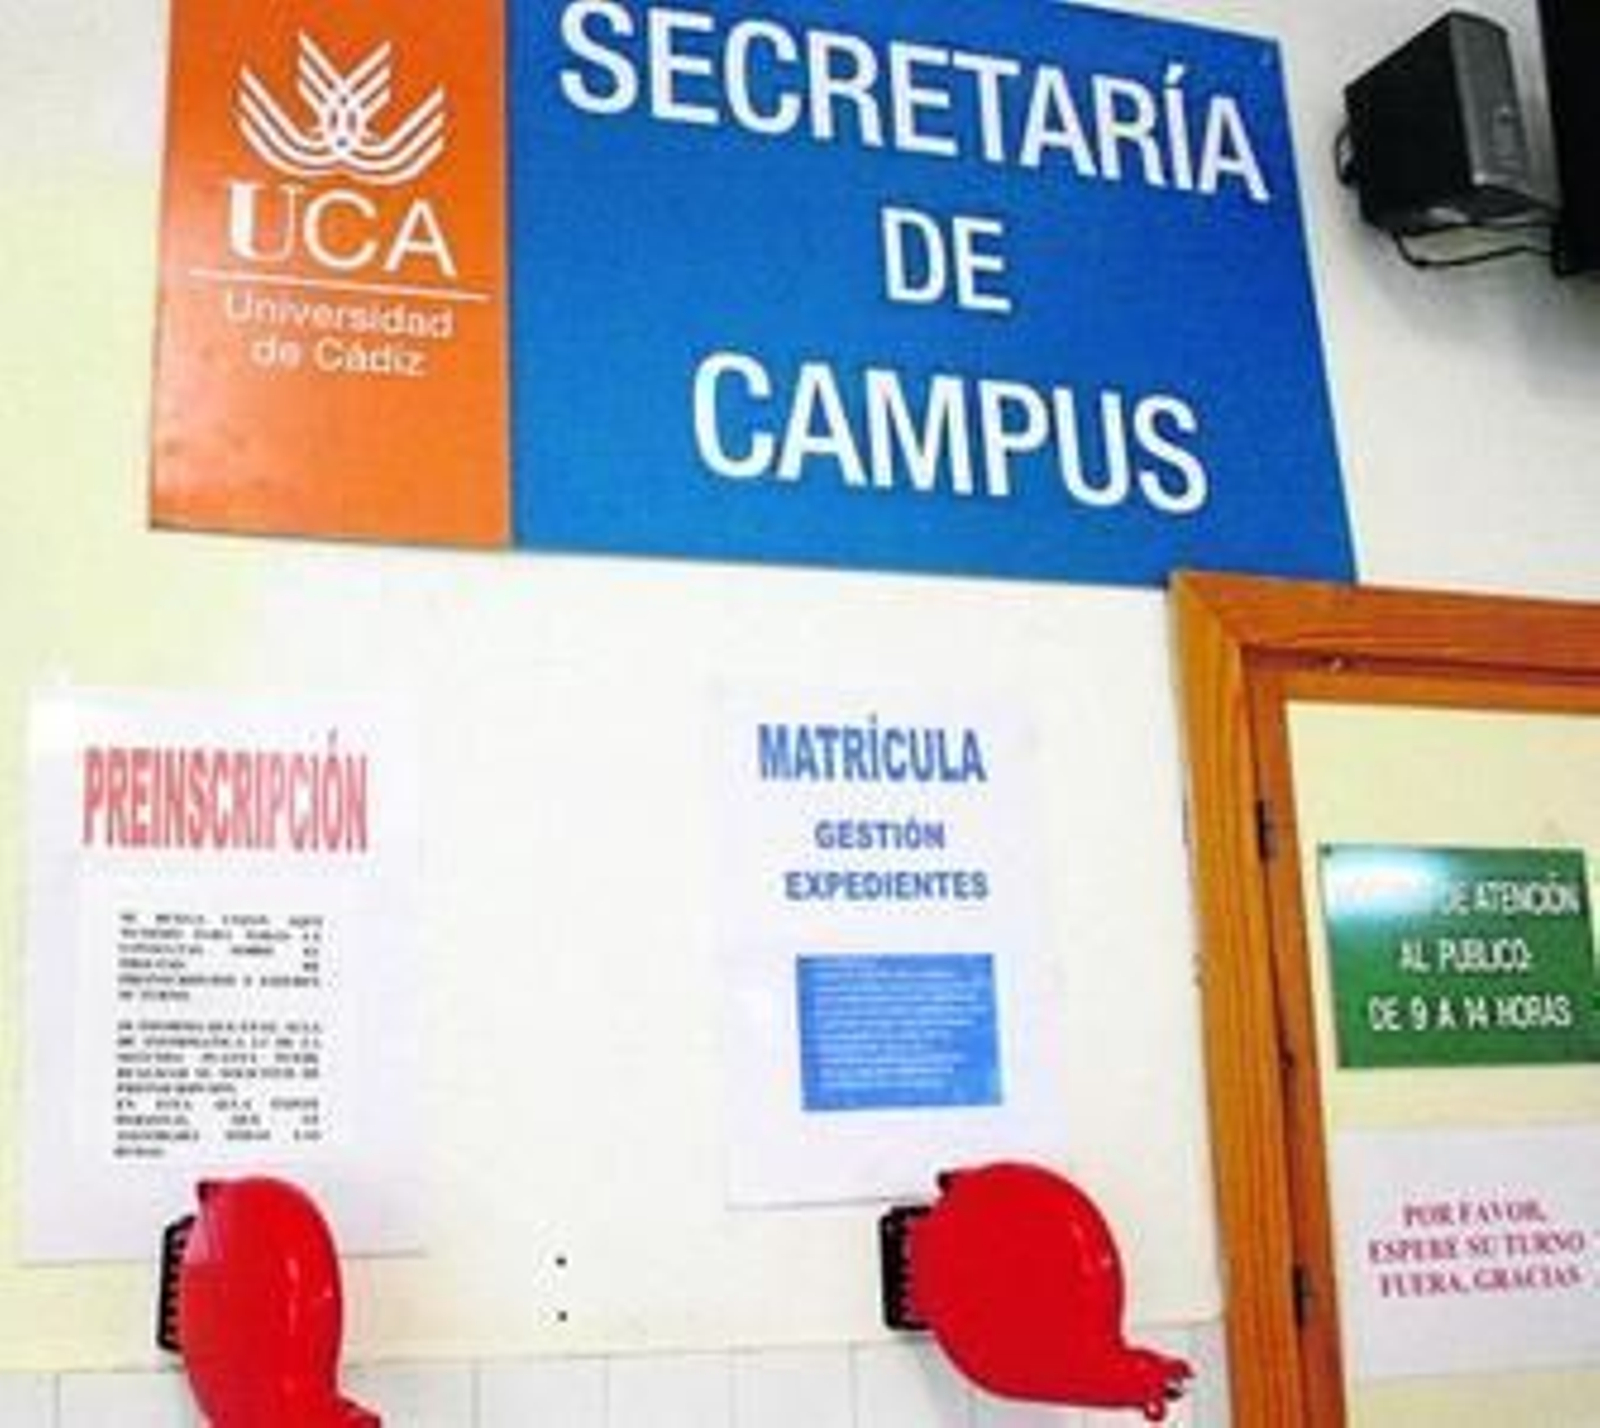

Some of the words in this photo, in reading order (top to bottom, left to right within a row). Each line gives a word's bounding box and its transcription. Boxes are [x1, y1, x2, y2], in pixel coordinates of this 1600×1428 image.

[558, 0, 1272, 203] SECRETARÍA
[225, 180, 458, 278] UCA
[880, 207, 1013, 313] DE
[224, 290, 455, 340] Universidad
[252, 336, 302, 366] de
[312, 336, 428, 377] Cádiz
[691, 352, 1209, 514] CAMPUS
[757, 713, 988, 783] MATRÍCULA
[82, 727, 368, 854] PREINSCRIPCIÓN
[813, 818, 946, 851] GESTIÓN
[783, 870, 990, 902] EXPEDIENTES
[1472, 872, 1581, 916] ATENCIÓN
[1400, 936, 1432, 974] AL
[1368, 996, 1403, 1033] DE
[1410, 996, 1429, 1032] 9
[1437, 996, 1457, 1031] A
[1463, 996, 1491, 1030] 14
[1496, 993, 1573, 1030] HORAS
[1403, 1203, 1455, 1228] POR
[1368, 1238, 1458, 1265] ESPERE
[1465, 1234, 1500, 1257] SU
[1505, 1231, 1586, 1257] TURNO
